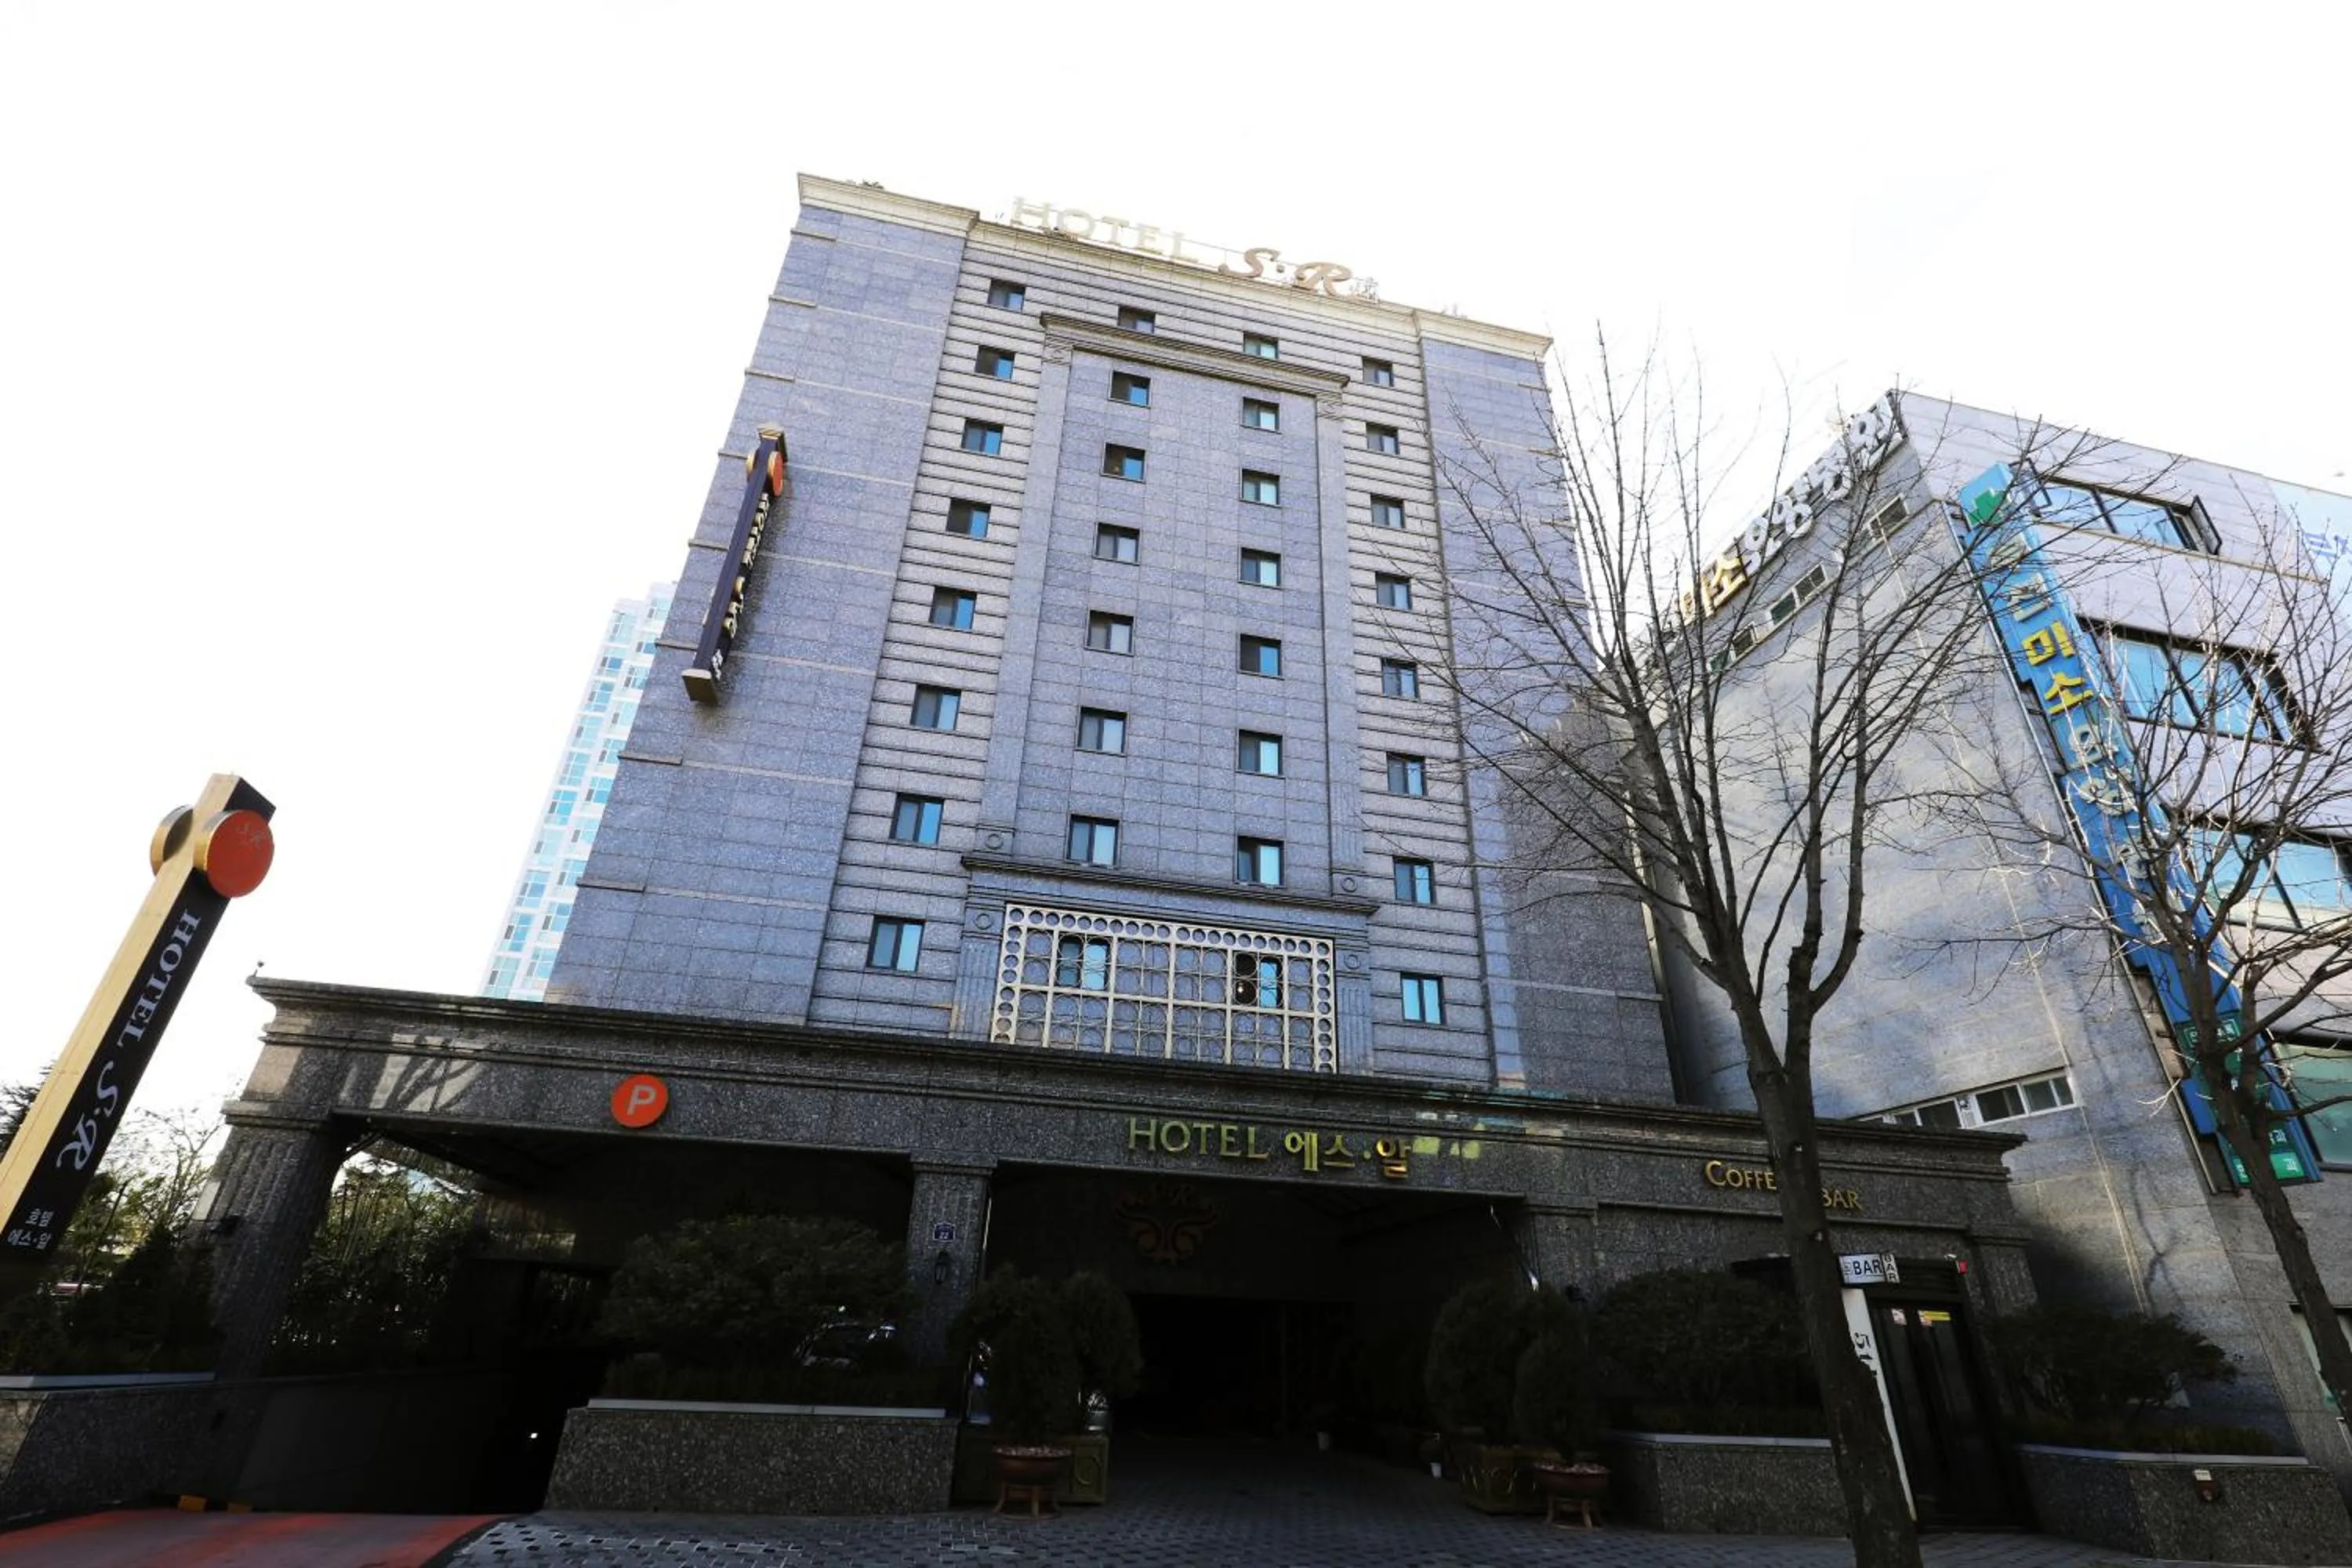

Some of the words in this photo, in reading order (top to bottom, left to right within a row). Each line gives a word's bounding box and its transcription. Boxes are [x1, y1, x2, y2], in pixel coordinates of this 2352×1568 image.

[1010, 196, 1200, 264] HOTEL
[115, 909, 202, 1049] HOTEL
[626, 1084, 656, 1116] P
[1127, 1116, 1269, 1160] HOTEL
[1853, 1258, 1882, 1276] BAR
